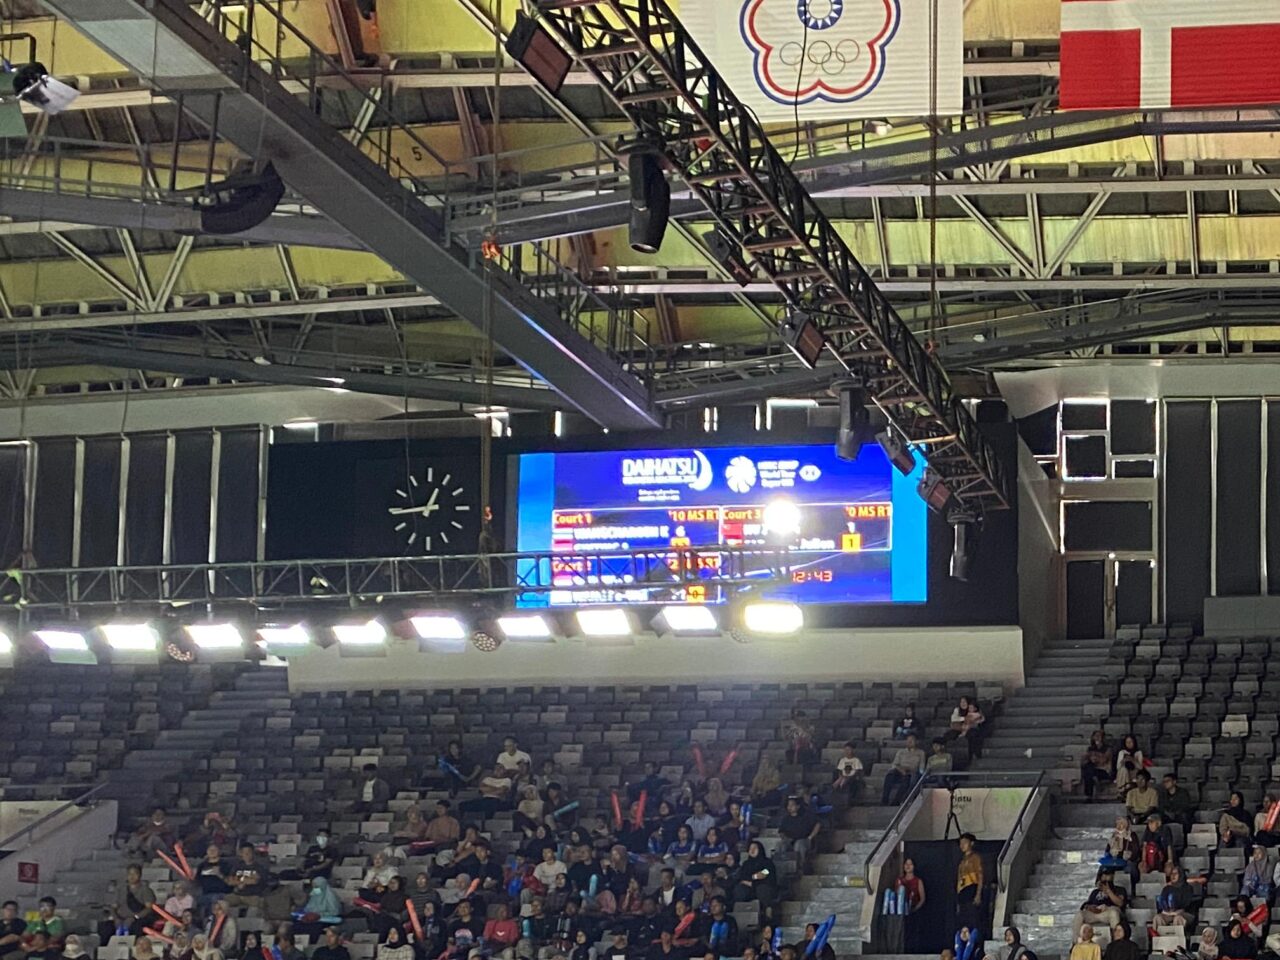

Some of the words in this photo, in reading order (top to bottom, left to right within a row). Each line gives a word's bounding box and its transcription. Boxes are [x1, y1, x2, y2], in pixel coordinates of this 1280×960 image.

[623, 458, 697, 477] DAIHATSU
[688, 509, 705, 521] MS
[723, 510, 752, 520] Court
[858, 506, 876, 517] MS
[554, 513, 584, 525] Court
[792, 571, 833, 582] 12:43
